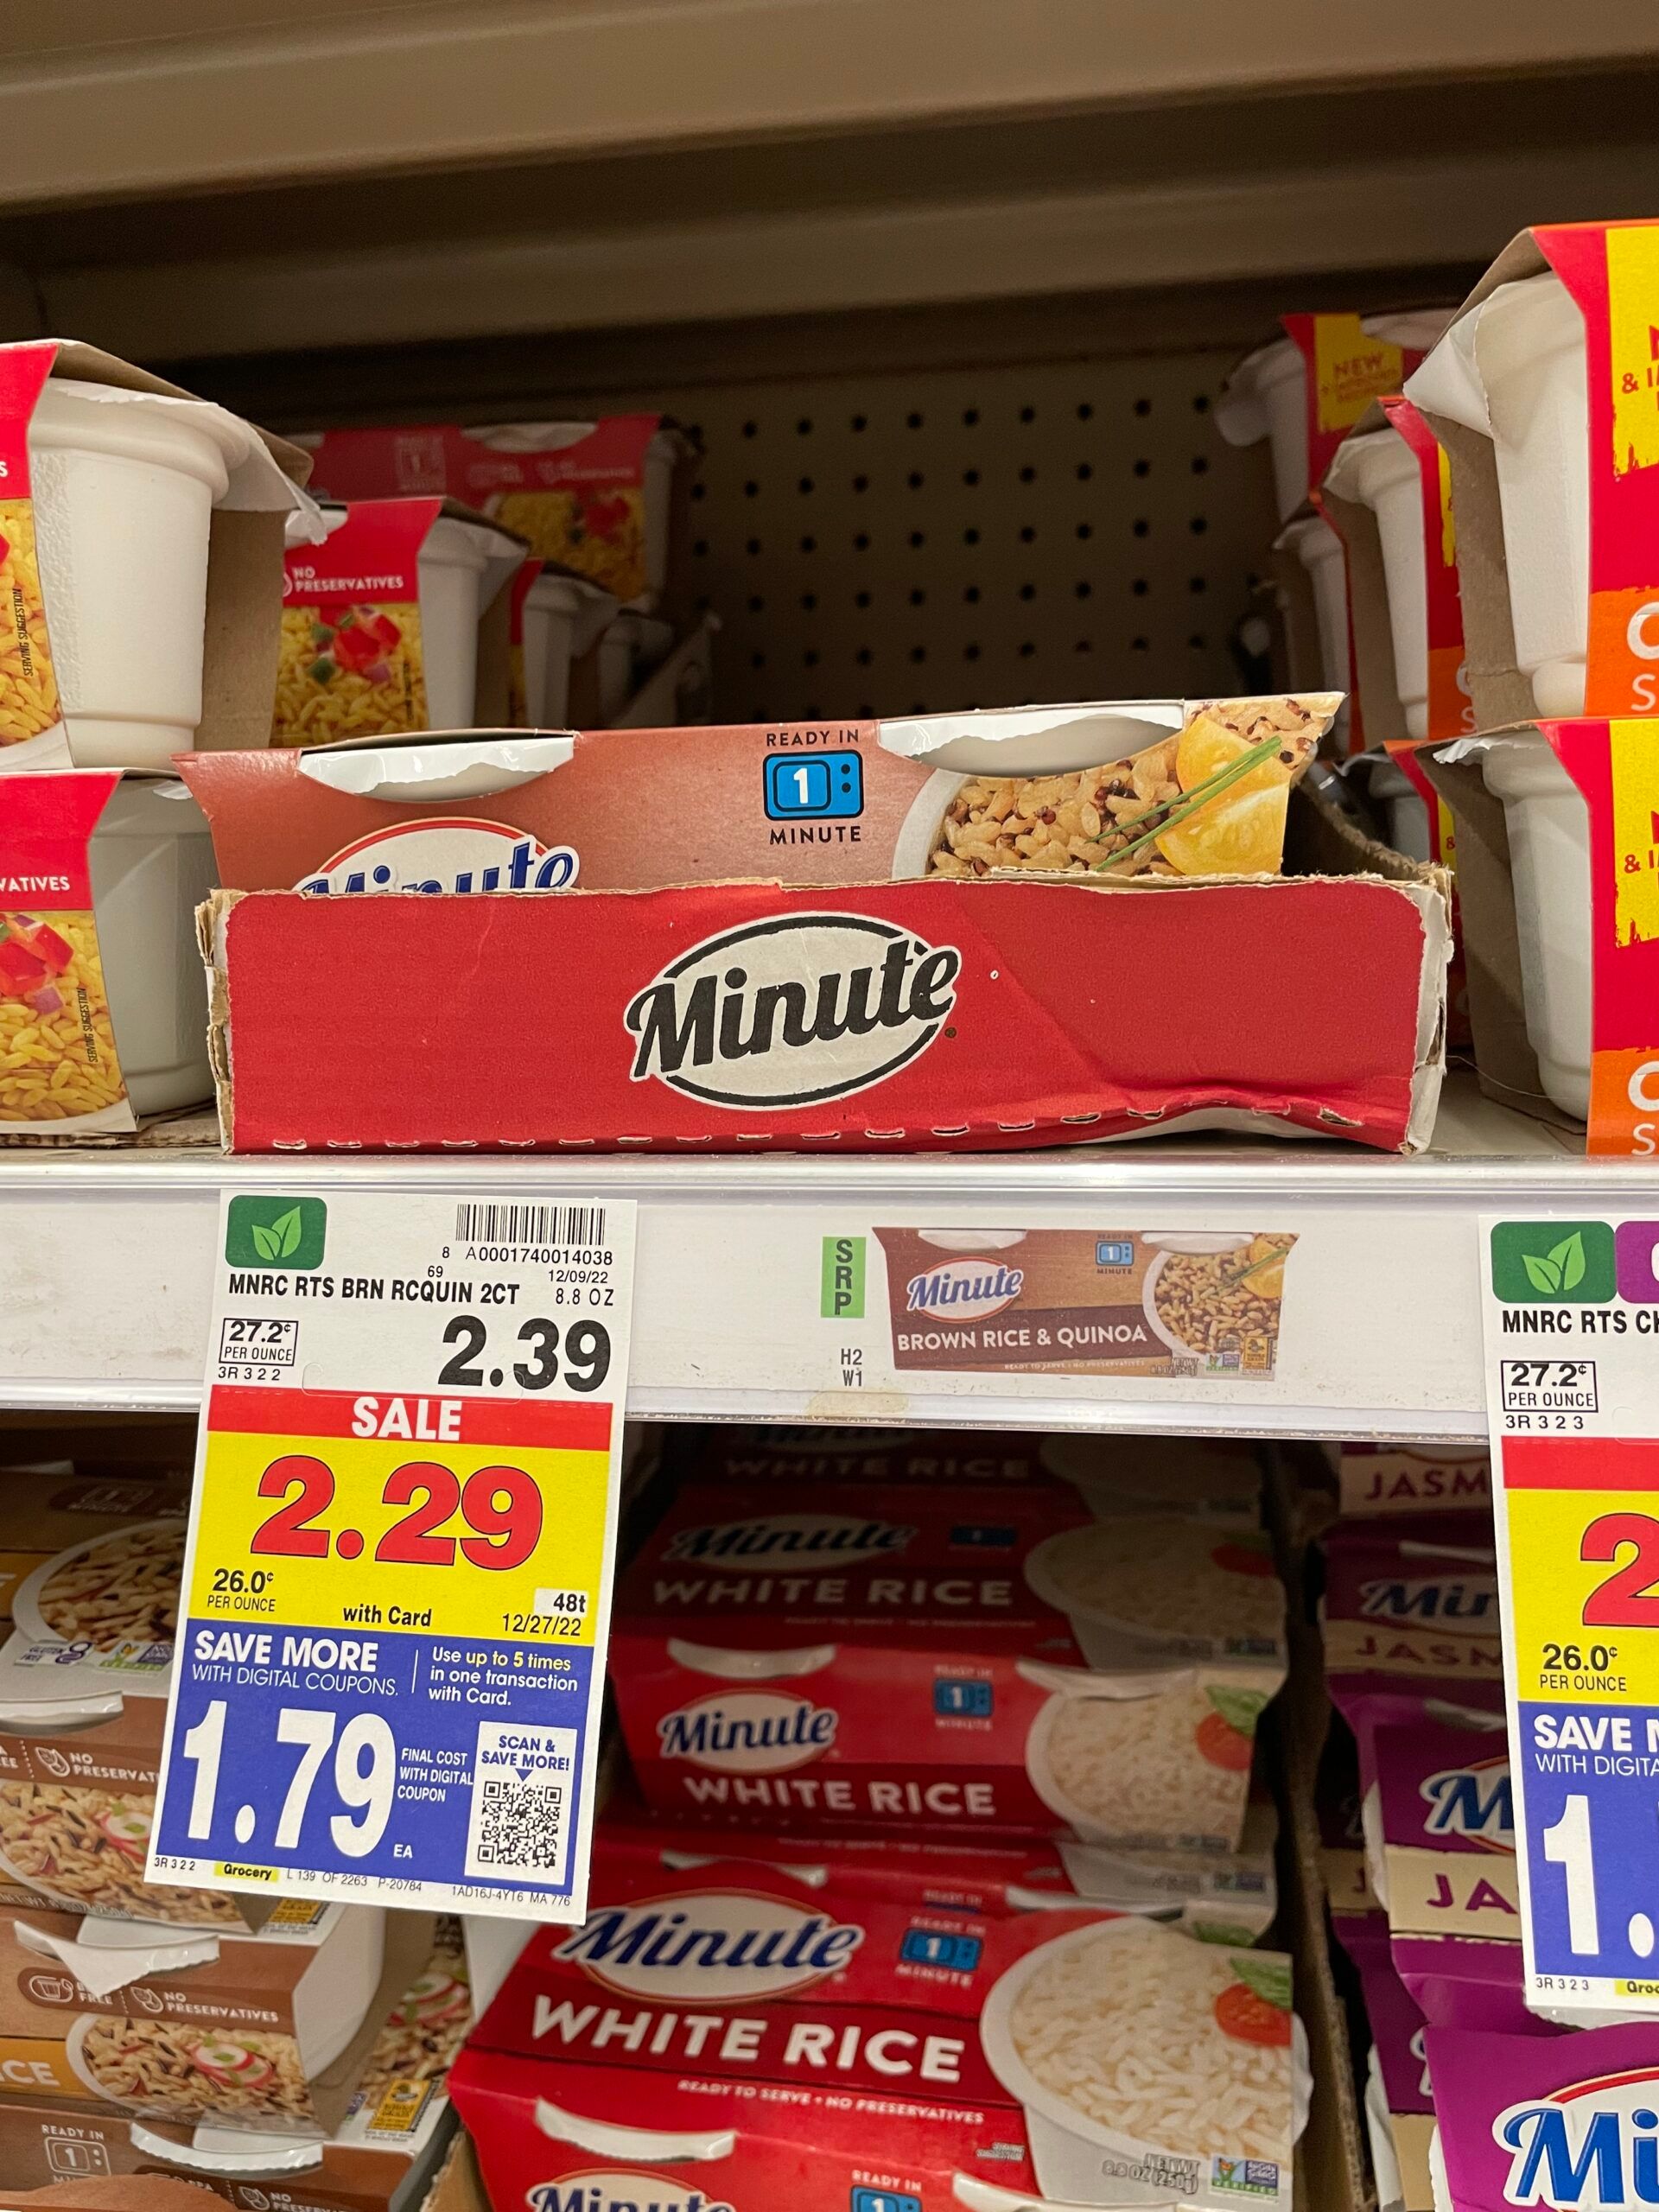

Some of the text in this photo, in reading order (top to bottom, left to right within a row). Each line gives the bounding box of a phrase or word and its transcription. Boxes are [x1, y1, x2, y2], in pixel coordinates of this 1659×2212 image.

[293, 567, 315, 580] NO
[295, 576, 404, 593] PRESERVATIVES
[12, 588, 34, 677] SERVING SUGGESTION
[766, 729, 859, 747] READY IN
[793, 767, 809, 804] 1
[770, 826, 861, 845] MINUTE
[626, 939, 959, 1077] Minute
[76, 987, 99, 1064] SERVING SUGGESTION
[442, 1247, 613, 1266] 8 A0001740014038
[1107, 1246, 1115, 1260] 1
[428, 1266, 443, 1278] 69
[549, 1270, 608, 1284] 12/09/22
[229, 1274, 520, 1305] MNRC RTS BRN RCQUIN 2CT
[556, 1287, 614, 1306] 8.8 OZ
[907, 1268, 1022, 1310] Minute
[1503, 1310, 1627, 1333] MNRC RTS
[897, 1325, 1148, 1351] BROWN RICE & QUINOA
[225, 1346, 292, 1361] PER OUNCE
[437, 1315, 611, 1392] 2.39
[840, 1349, 862, 1365] H2
[219, 1366, 238, 1379] 3R
[842, 1370, 863, 1387] W1
[1509, 1392, 1594, 1408] PER OUNCE
[351, 1396, 462, 1441] SALE
[1505, 1415, 1530, 1428] 3R
[723, 1458, 1031, 1479] WHITE RICE
[251, 1454, 543, 1571] 2.29
[680, 1522, 914, 1556] Minute
[553, 1592, 587, 1613] 48t
[652, 1579, 1015, 1607] WHITE RICE
[207, 1594, 276, 1613] PER OUNCE
[343, 1605, 432, 1628] with Card
[502, 1612, 582, 1637] 12/27/22
[193, 1630, 272, 1663] SAVE
[282, 1636, 378, 1673] MORE
[432, 1646, 571, 1671] Use up to 5 times
[192, 1663, 399, 1696] WITH DIGITAL COUPONS.
[430, 1665, 578, 1692] in one transaction
[1540, 1675, 1626, 1691] PER OUNCE
[429, 1687, 512, 1706] with Card.
[662, 1706, 833, 1752] Minute
[1534, 1714, 1632, 1751] SAVE
[499, 1735, 556, 1752] SCAN &
[70, 1753, 93, 1764] NO
[401, 1747, 467, 1766] FINAL COST
[481, 1751, 569, 1771] SAVE MORE!
[1535, 1753, 1586, 1774] WITH
[182, 1700, 397, 1858] 1.79
[400, 1766, 474, 1786] WITH DIGITAL
[397, 1785, 446, 1802] COUPON
[683, 1777, 998, 1817] WHITE RICE
[393, 1843, 413, 1859] EA
[154, 1857, 168, 1868] 3R
[224, 1864, 272, 1881] Grocery
[298, 1870, 315, 1881] 139
[322, 1872, 338, 1884] OF
[341, 1874, 368, 1886] 2263
[378, 1878, 423, 1892] P-20784
[530, 1892, 547, 1904] MA
[551, 1895, 570, 1906] 776
[562, 1910, 859, 1968] Minute
[926, 1938, 941, 1958] 1
[896, 1964, 973, 1988] MINUTE
[1535, 1977, 1554, 1989] 3R
[164, 1992, 187, 2004] NO
[167, 2002, 279, 2024] PRESERVATIVES
[532, 1995, 965, 2082] WHITE RICE
[0, 2061, 60, 2087] CE
[677, 2080, 985, 2125] READY TO SERVE NO PRESERVATIVES
[41, 2125, 105, 2140] READY IN
[65, 2147, 77, 2167] 1
[851, 2170, 922, 2192] READY IN
[270, 2190, 291, 2202] NO
